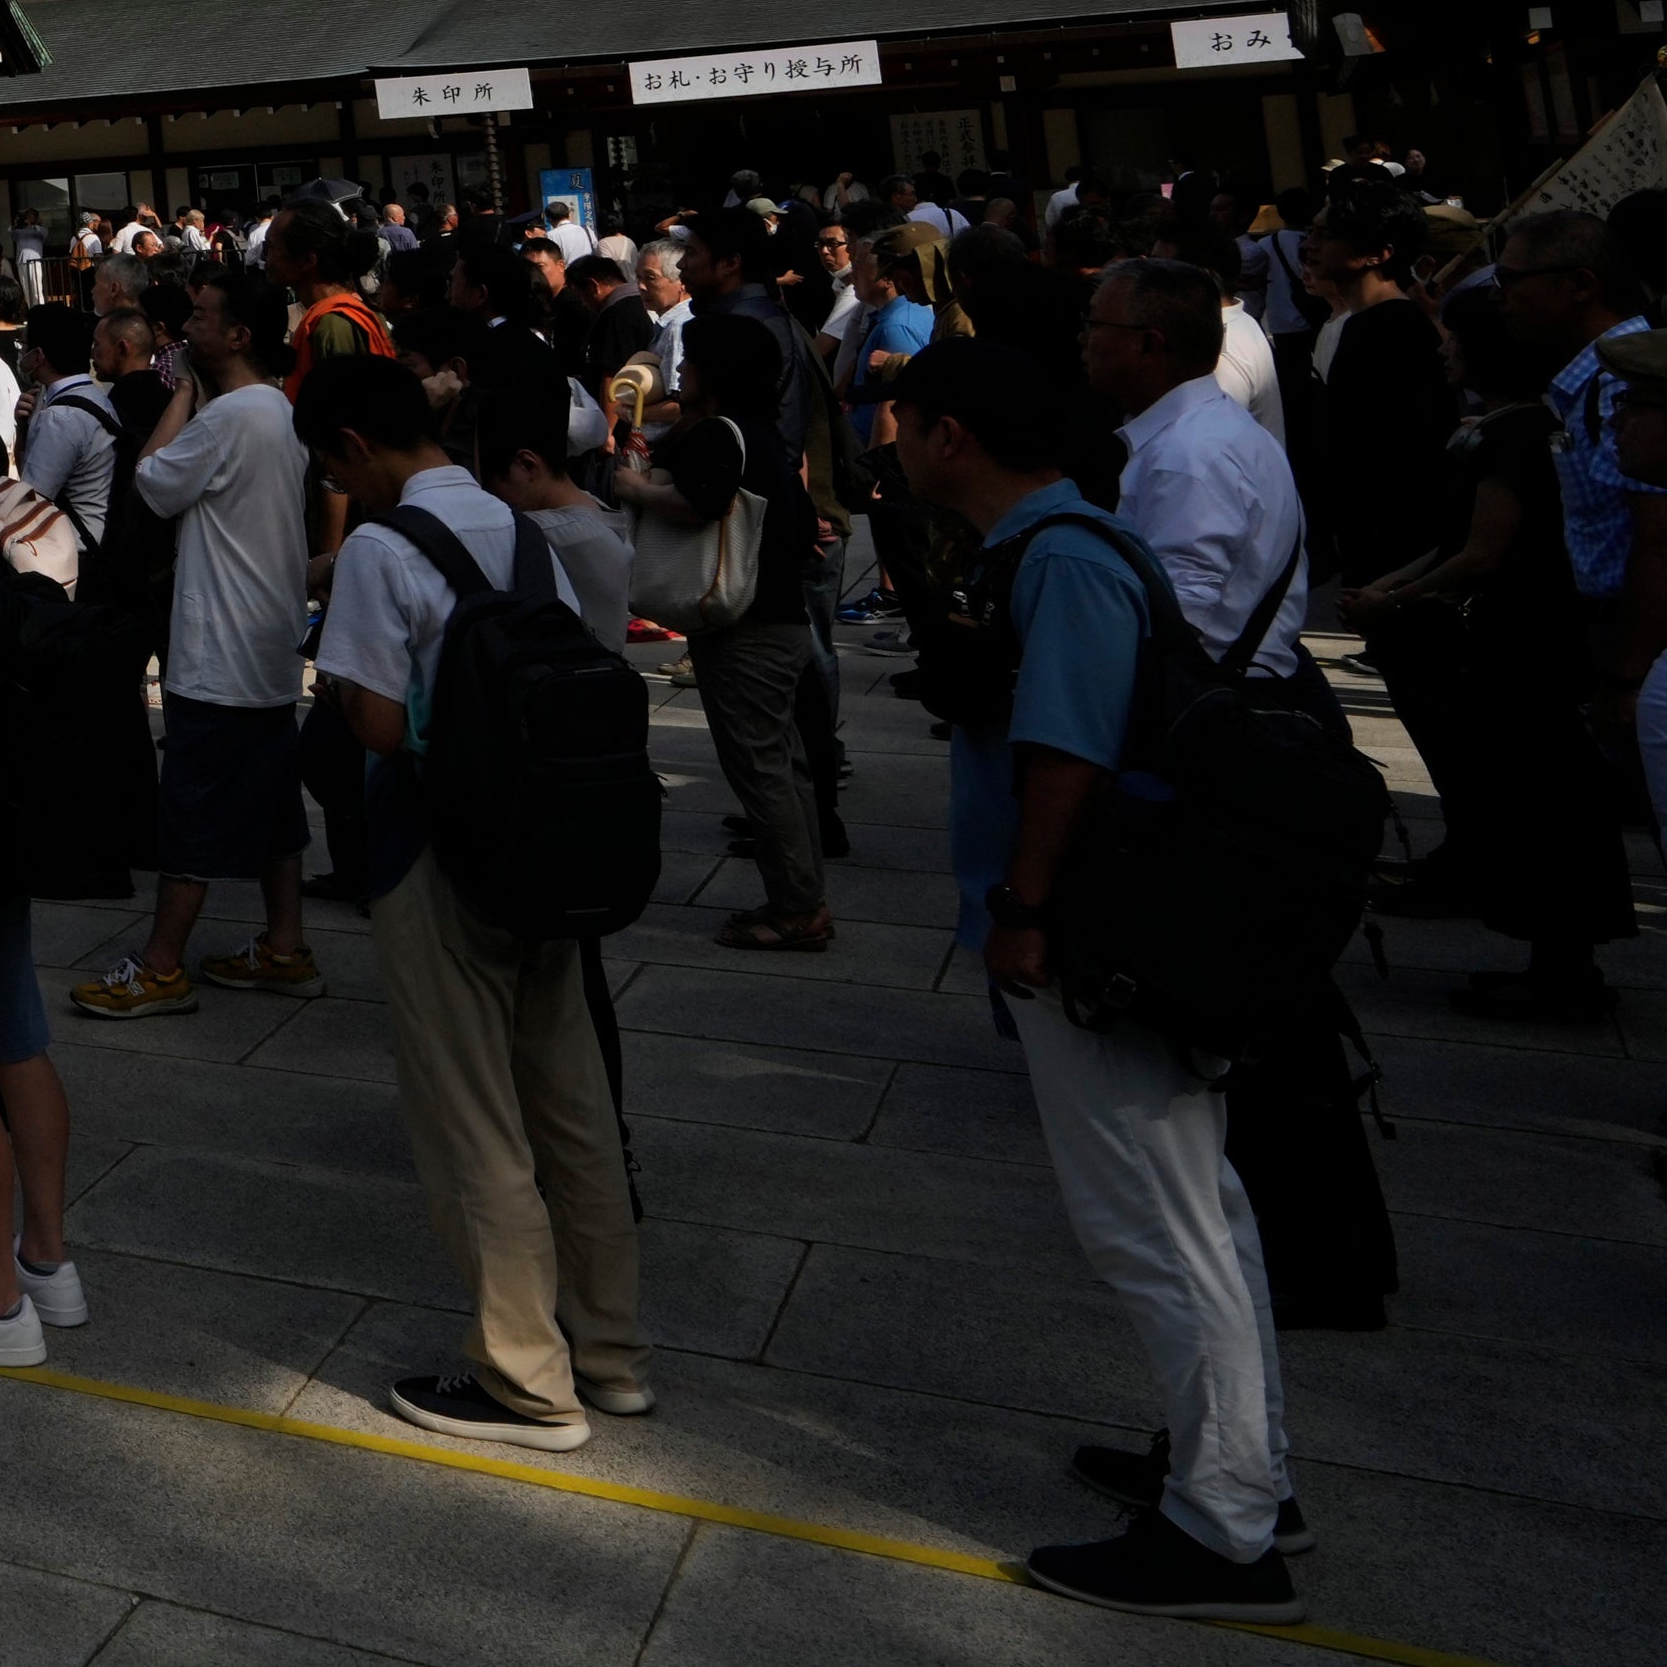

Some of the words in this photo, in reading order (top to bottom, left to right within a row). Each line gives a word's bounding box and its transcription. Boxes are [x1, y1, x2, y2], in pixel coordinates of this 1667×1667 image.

[1211, 30, 1292, 51] おみ
[644, 54, 863, 90] お札・お守り授与所
[412, 82, 494, 106] 朱印所
